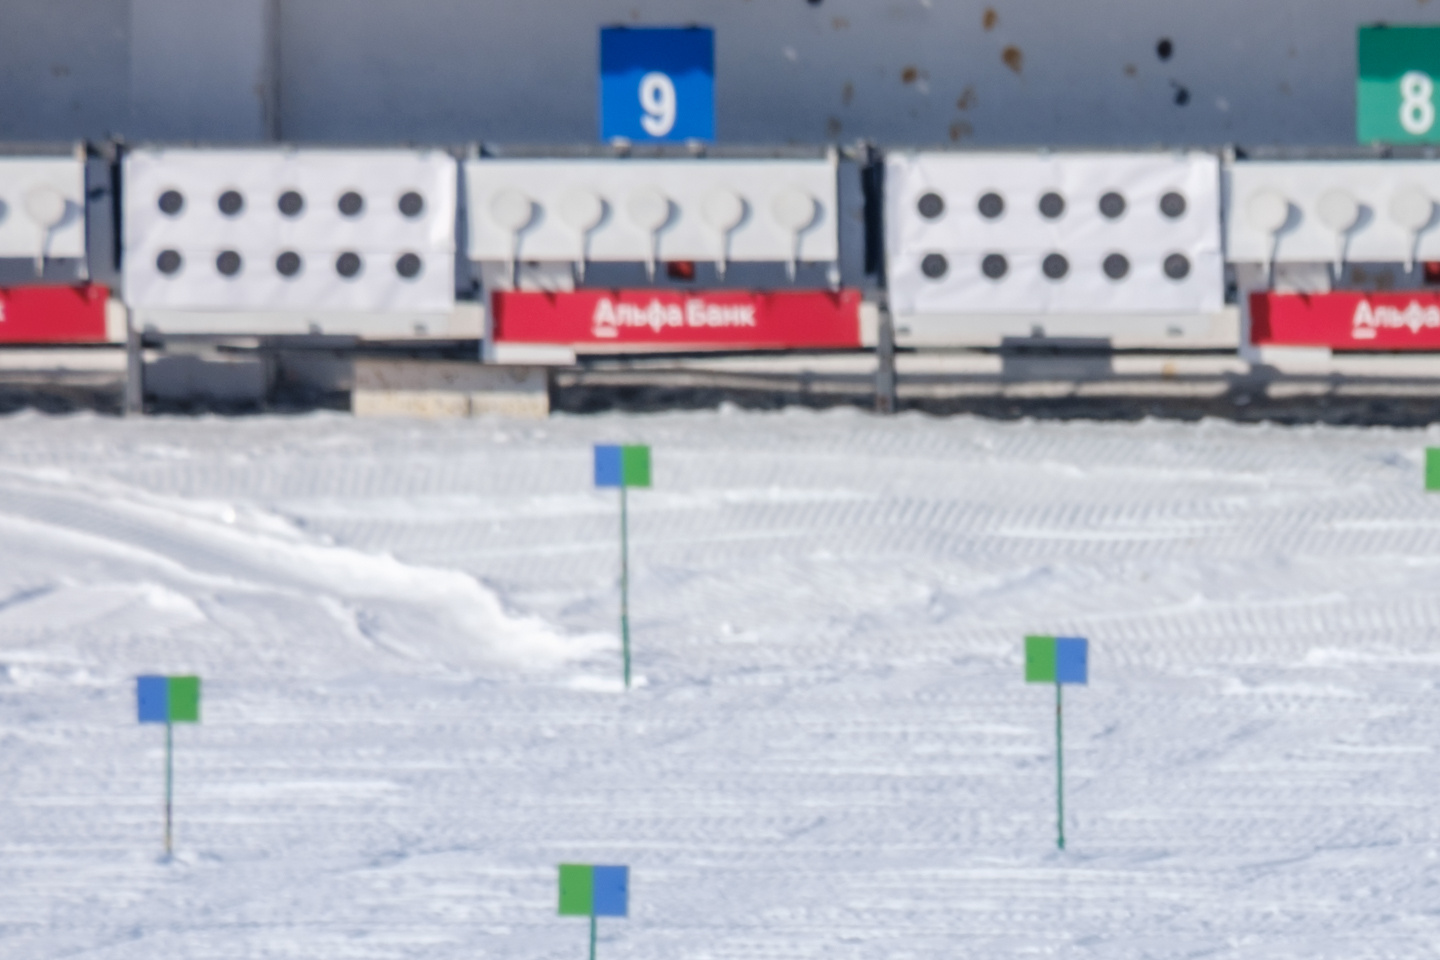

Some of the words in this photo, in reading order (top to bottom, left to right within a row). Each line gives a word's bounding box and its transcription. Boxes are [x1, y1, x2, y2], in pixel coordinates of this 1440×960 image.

[638, 71, 676, 137] 9
[1400, 70, 1435, 135] 8
[593, 298, 683, 334] Альфа
[685, 299, 755, 327] Банк
[1353, 299, 1440, 335] Альфа
